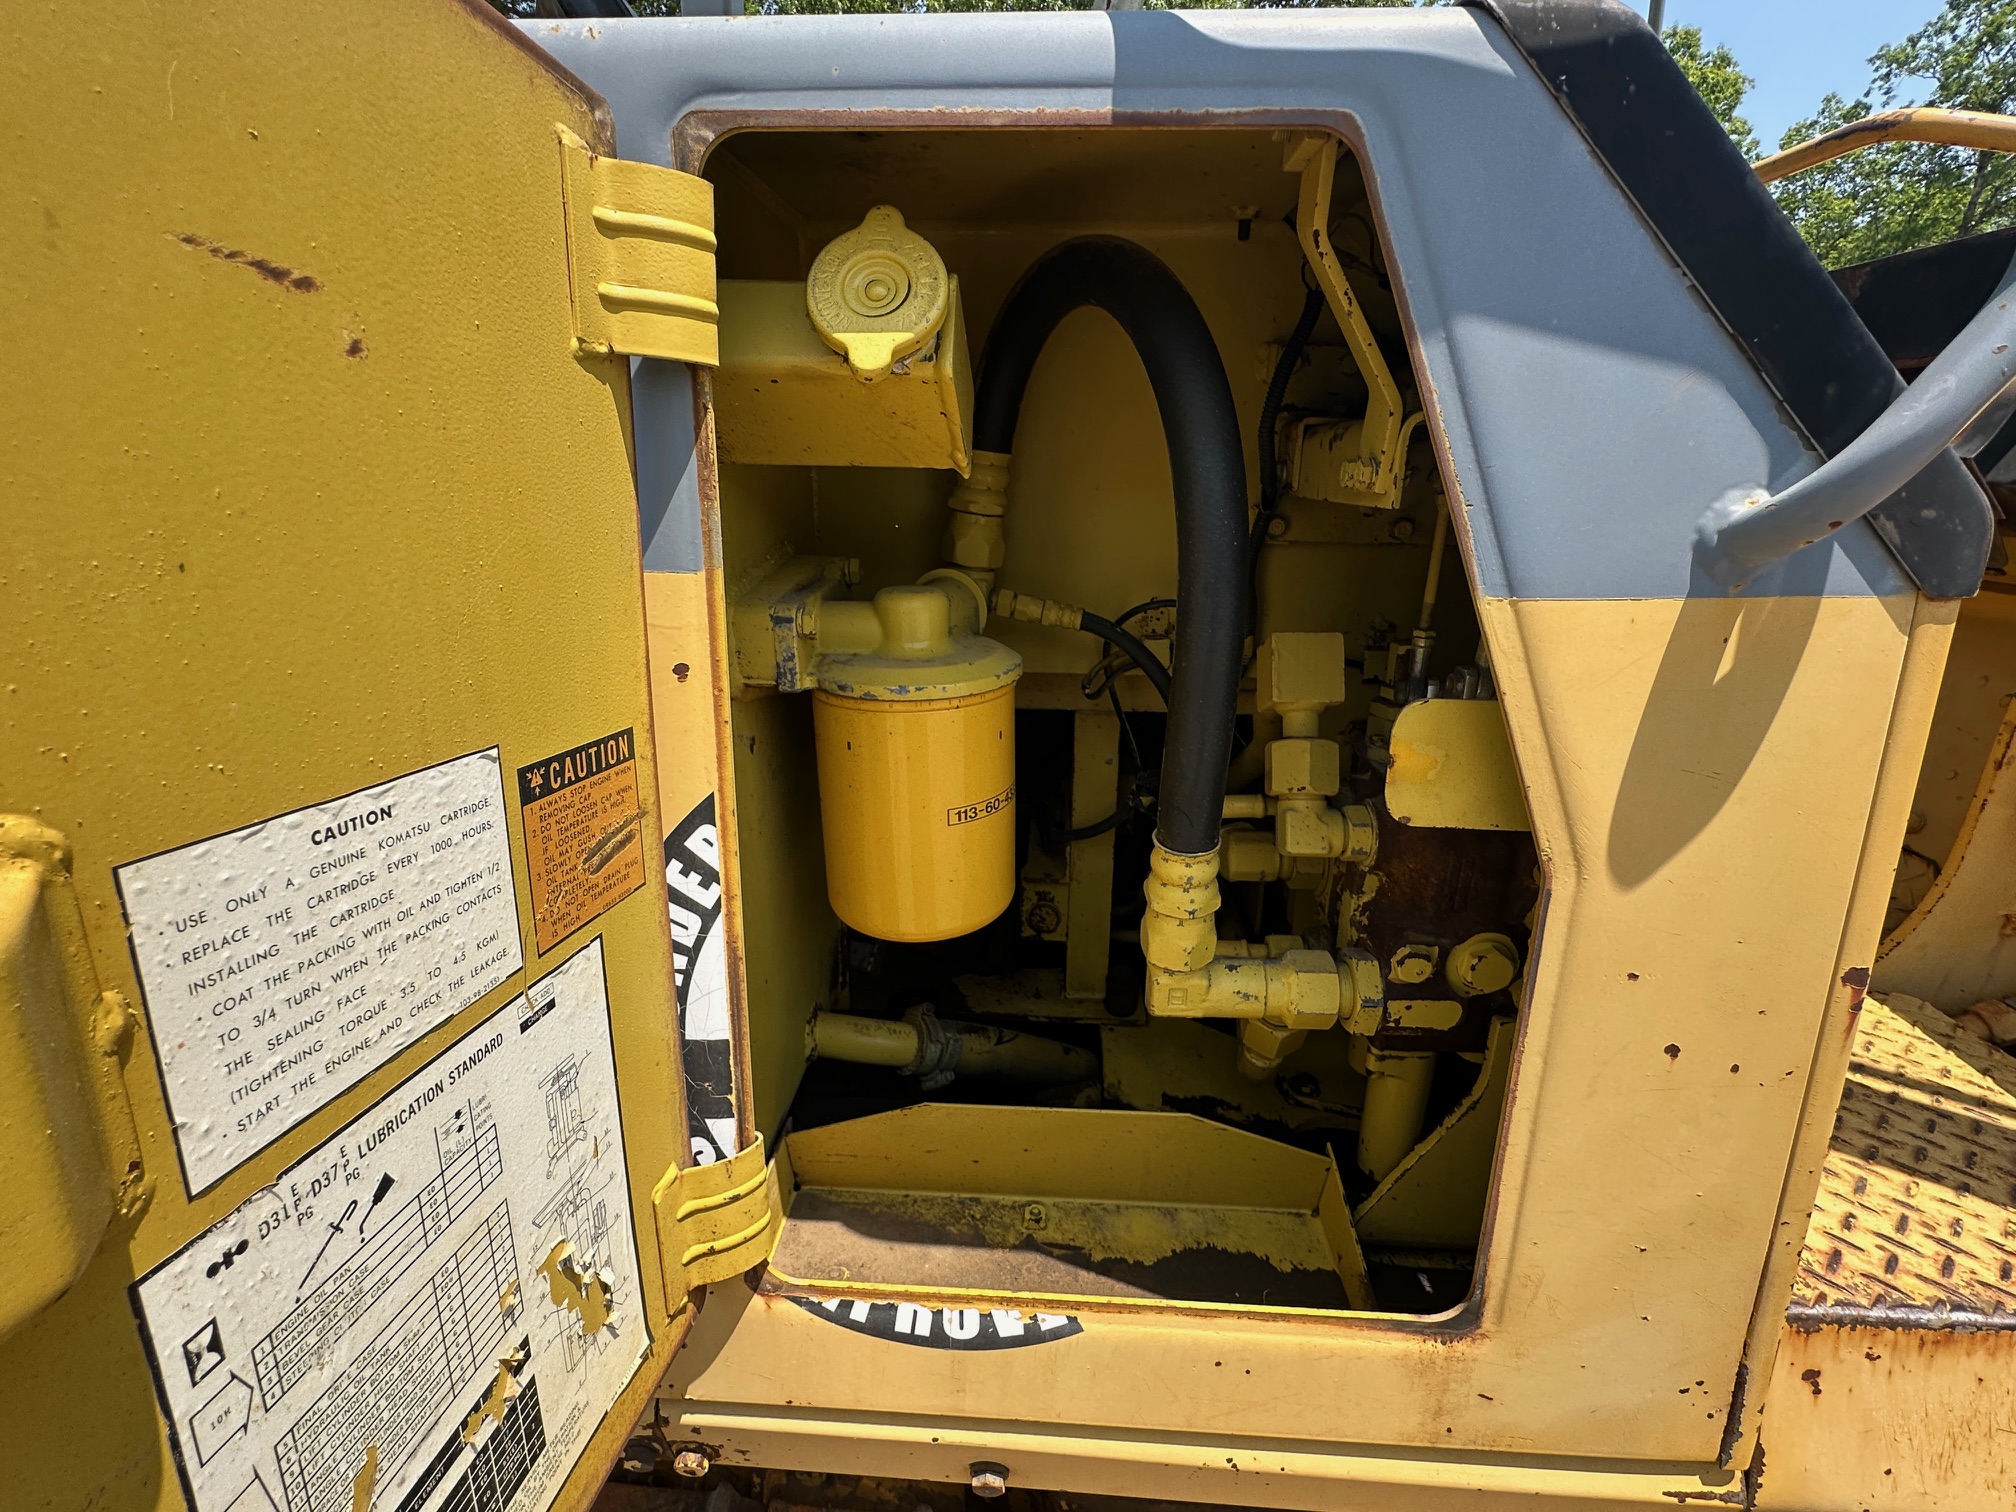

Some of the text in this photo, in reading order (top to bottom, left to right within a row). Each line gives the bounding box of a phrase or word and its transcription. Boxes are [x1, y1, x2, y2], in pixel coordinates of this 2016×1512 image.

[537, 792, 567, 813] ALWAYS
[569, 783, 586, 798] STOP
[589, 772, 611, 789] ENGINE
[613, 763, 631, 778] WHEN
[550, 734, 629, 789] CAUTION
[310, 804, 392, 847] CAUTION
[539, 791, 593, 823] REMOVING CAP.
[540, 821, 551, 834] DO
[554, 813, 569, 827] NOT
[572, 799, 597, 818] LOOSEN
[600, 792, 612, 805] CAP
[541, 832, 553, 845] OIL
[556, 809, 598, 837] TEMPERATURE
[601, 805, 607, 815] IS
[175, 797, 491, 934] USE ONLY A GENUINE KOMATSU CARTRIDGE.
[542, 845, 548, 856] IF
[543, 853, 555, 866] OIL
[558, 843, 573, 858] MAY
[545, 855, 571, 877] SLOWLY
[546, 862, 578, 887] OIL TANK
[181, 819, 493, 965] REPLACE THE CARTRIDGE EVERY 1000 HOURS.
[550, 908, 571, 928] WHEN
[576, 899, 586, 912] OIL
[591, 871, 630, 902] TEMPERATURE
[565, 893, 578, 908] NOT
[582, 880, 599, 897] OPEN
[603, 867, 620, 884] DRAIN
[624, 856, 638, 871] PLUG
[188, 888, 394, 996] INSTALLING THE CARTRIDGE
[211, 862, 499, 1019] COAT THE PACKING WITH OIL AND TIGHTEN 1/2
[552, 912, 582, 938] IS HIGH.
[217, 883, 501, 1048] TO 3/4 TURN WHEN THE PACKING CONTACTS
[224, 984, 366, 1076] THE SEALING FACE
[230, 930, 499, 1105] (TIGHTENING TORQUE 3.5 TO 4.5 KGM)
[236, 946, 509, 1133] START THE ENGINE AND CHECK THE LEAKAGE.
[258, 1203, 291, 1240] D31
[358, 1079, 445, 1158] LUBRICATION
[449, 1032, 504, 1086] STANDARD
[297, 1167, 360, 1226] PG PG
[275, 1266, 351, 1341] ENGINE OIL PAN
[348, 1264, 370, 1288] CASE
[371, 1277, 391, 1299] CASE
[282, 1341, 311, 1372] BEVEL
[316, 1311, 340, 1337] GEAR
[344, 1286, 365, 1310] CASE
[296, 1344, 377, 1434] FINAL CASE
[301, 1347, 391, 1448] HYDRAULIC OIL TANK
[304, 1438, 323, 1462] LIFT
[326, 1390, 366, 1436] CYLINDER
[370, 1351, 400, 1388] BOTTOM
[306, 1452, 326, 1476] LIFT
[330, 1402, 370, 1449] CYLINDER
[374, 1374, 395, 1400] HEAD
[398, 1344, 421, 1370] SHAFT
[310, 1456, 338, 1490] ANGLE
[342, 1404, 381, 1452] CYLINDER
[385, 1367, 414, 1400] BOTTOM
[418, 1336, 440, 1364] SHAFT
[429, 1372, 447, 1397] SHAFT
[314, 1469, 342, 1504] ANGLE
[346, 1417, 384, 1464] CYLINDER
[388, 1390, 408, 1414] HEAD
[411, 1359, 434, 1387] SHAFT
[340, 1474, 350, 1488] OR
[372, 1412, 400, 1446] CYLINDER
[388, 1405, 433, 1462] HEAD SHAFT
[414, 1466, 444, 1510] ELEMENT
